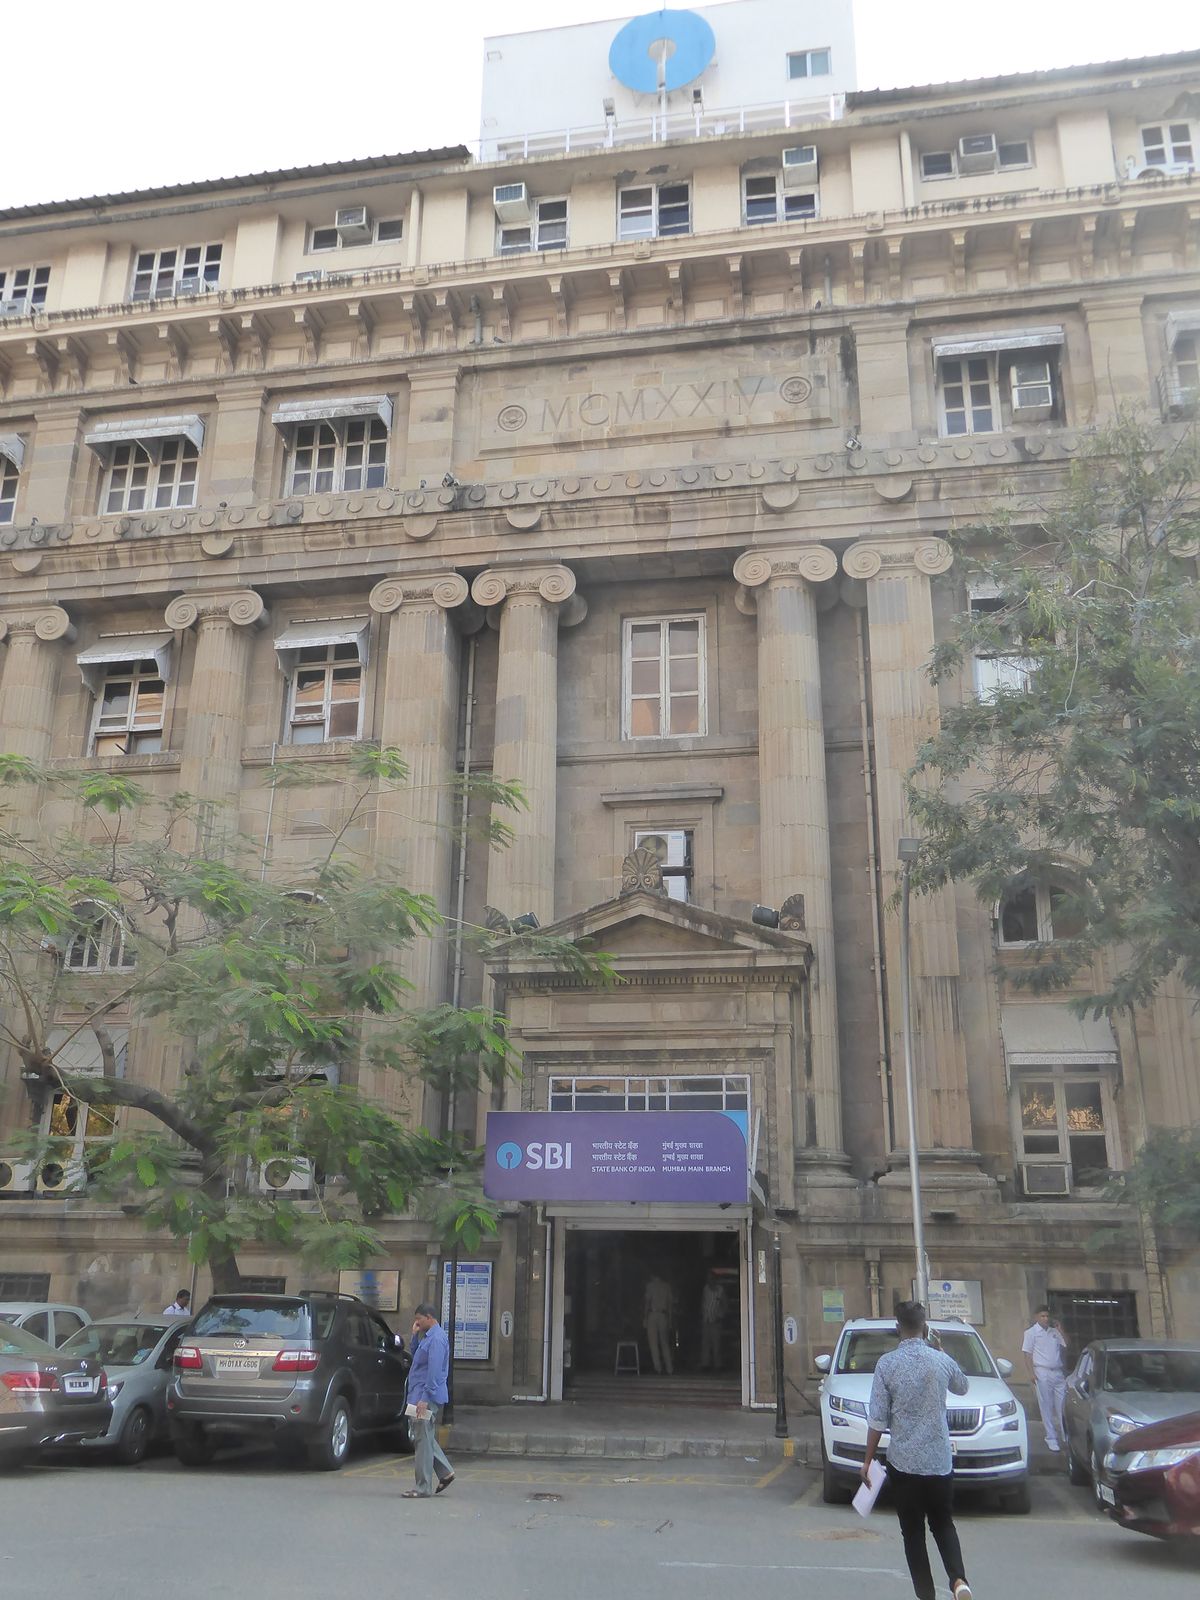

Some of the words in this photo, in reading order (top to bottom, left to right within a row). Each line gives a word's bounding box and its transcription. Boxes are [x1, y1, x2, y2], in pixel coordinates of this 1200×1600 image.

[540, 376, 765, 433] MCMXXIV
[592, 1141, 613, 1150] भारतीय
[614, 1141, 627, 1150] स्टेट
[525, 1142, 572, 1170] SBI
[592, 1152, 613, 1161] भारतीय
[613, 1152, 626, 1161] स्टेट
